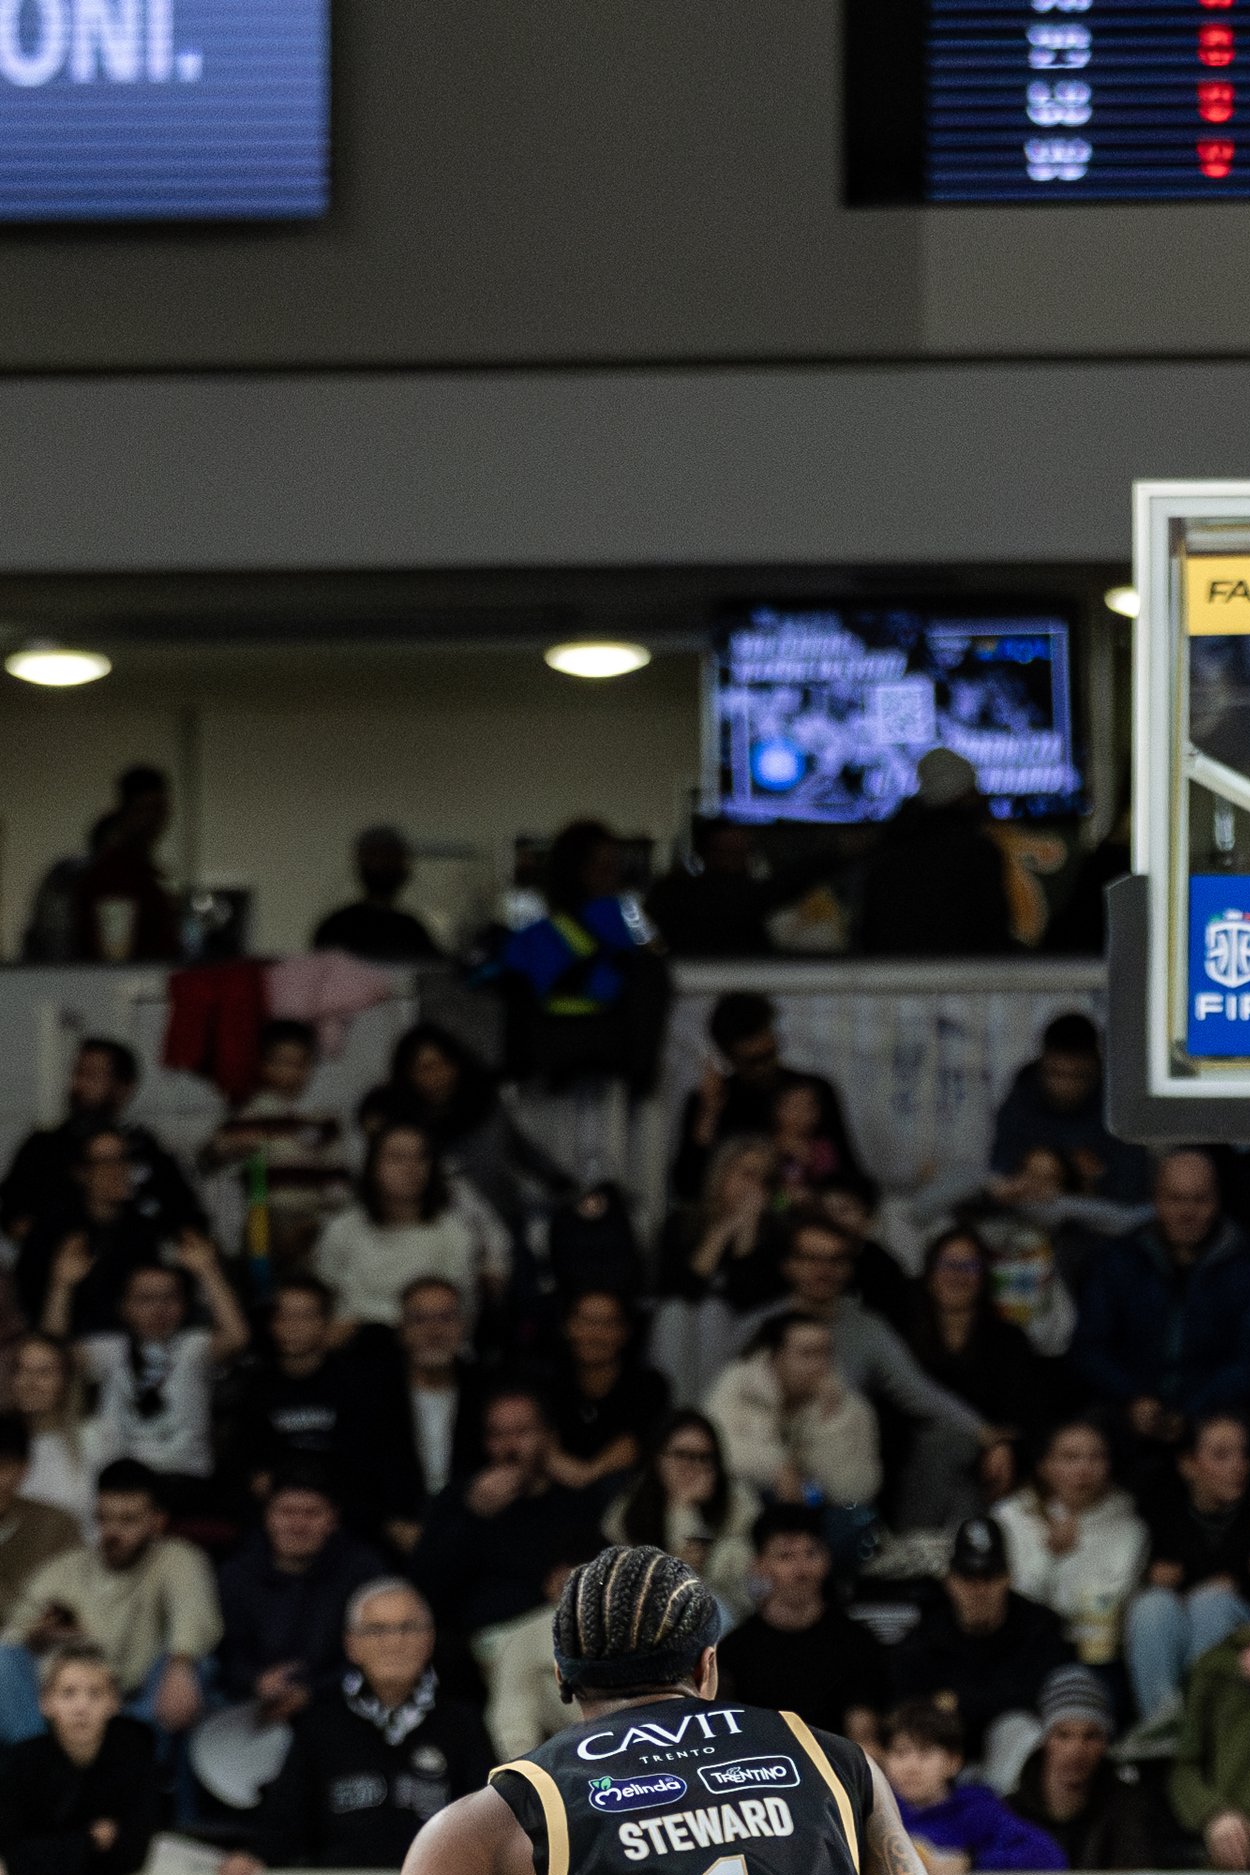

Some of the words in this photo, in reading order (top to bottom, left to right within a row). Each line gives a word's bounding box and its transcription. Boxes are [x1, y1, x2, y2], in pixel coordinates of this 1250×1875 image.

[576, 1709, 745, 1761] CAVIT
[638, 1746, 715, 1764] TRENTO
[710, 1764, 787, 1785] TRENTINO
[594, 1776, 682, 1806] Melinda
[618, 1796, 795, 1861] STEWARD
